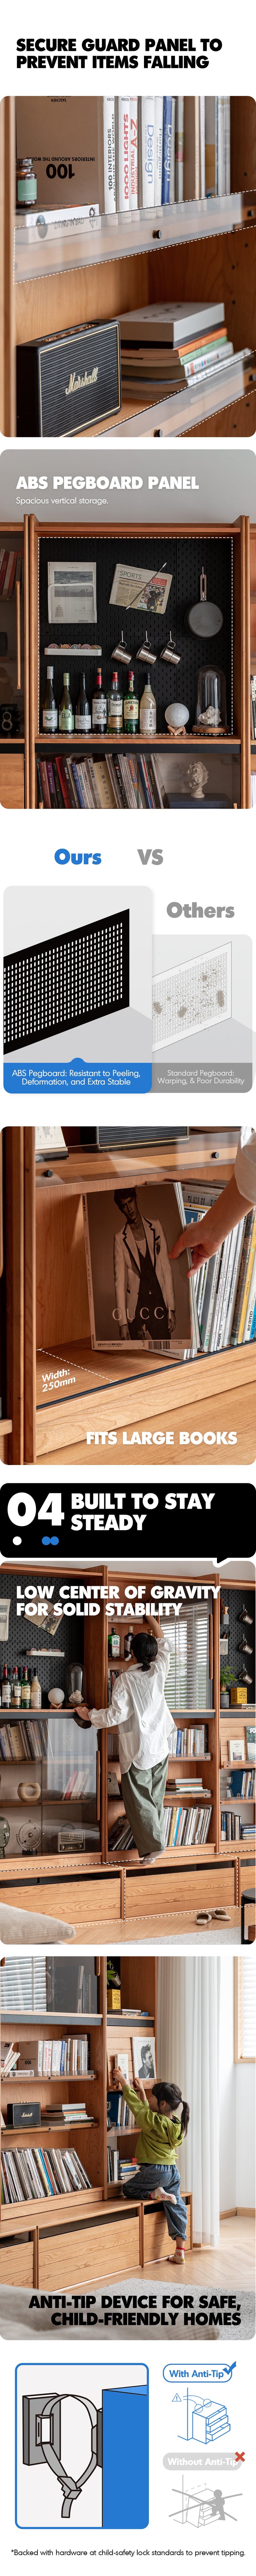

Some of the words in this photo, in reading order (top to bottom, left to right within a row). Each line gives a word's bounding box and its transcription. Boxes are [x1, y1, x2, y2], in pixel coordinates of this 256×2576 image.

[145, 125, 154, 183] Design
[46, 164, 75, 179] 100
[65, 367, 98, 394] Marshall
[120, 571, 142, 579] SPORTS
[101, 775, 110, 800] 设计心理学
[112, 1307, 171, 1320] GUCCI
